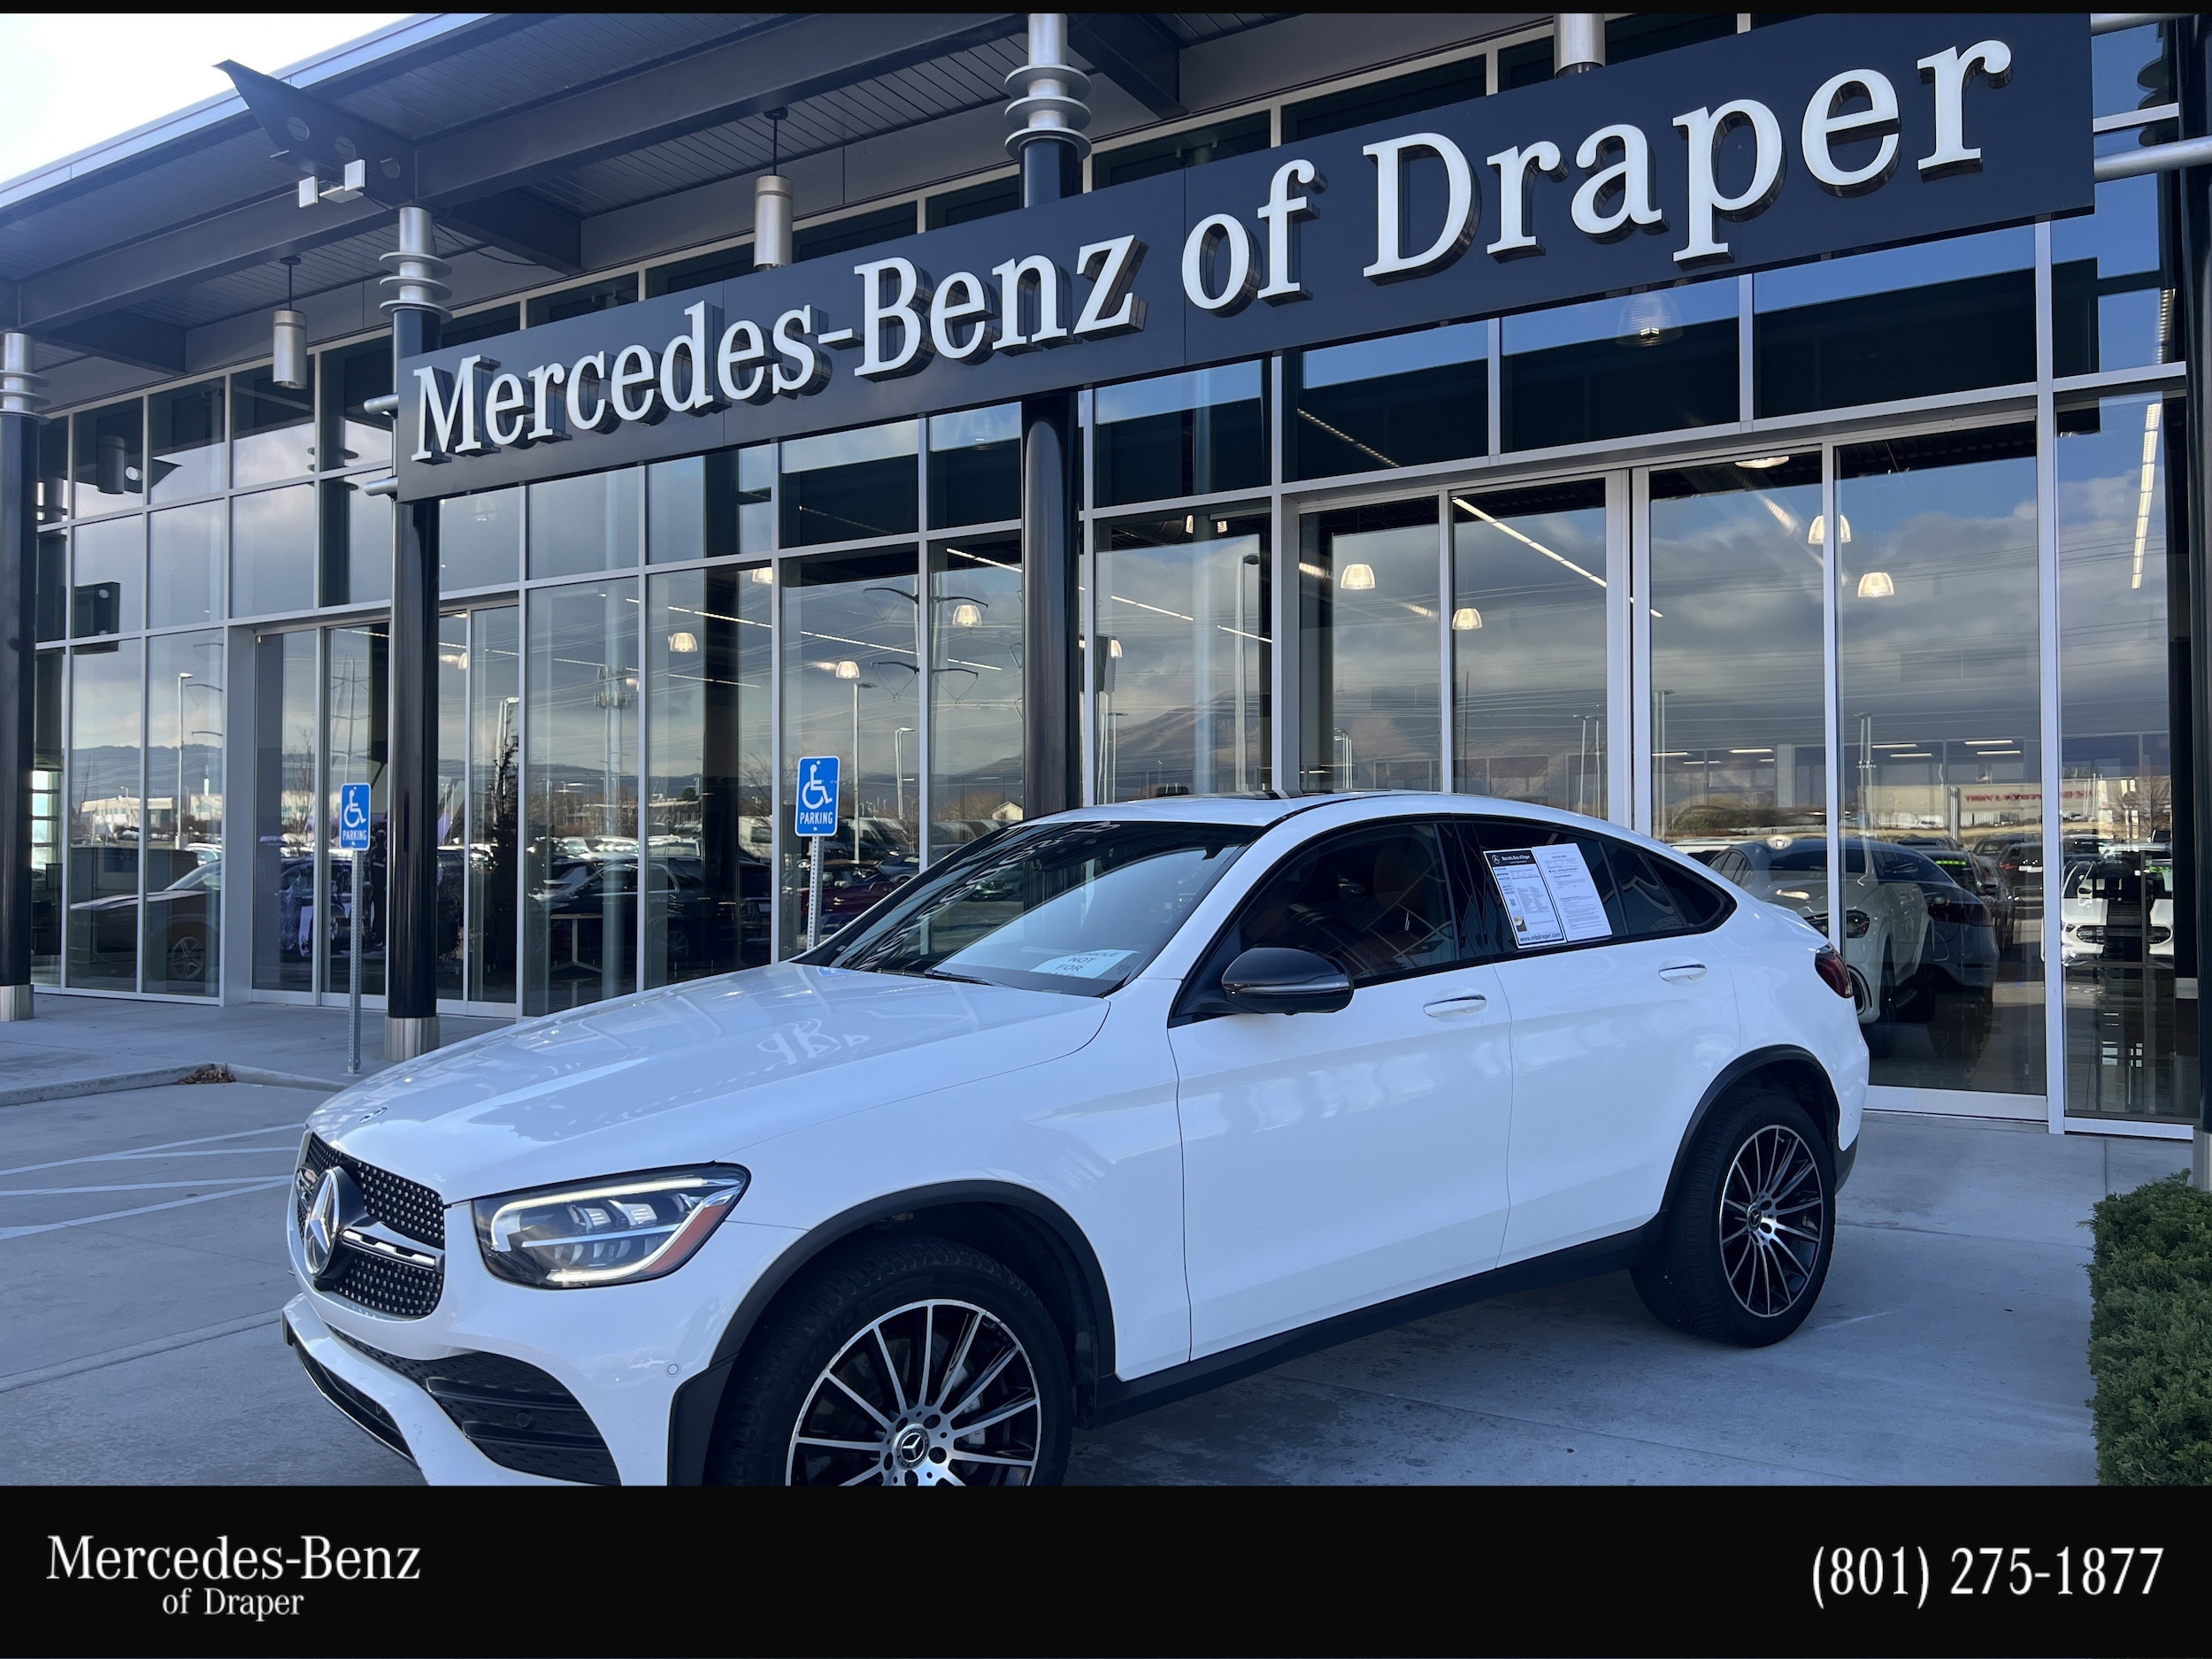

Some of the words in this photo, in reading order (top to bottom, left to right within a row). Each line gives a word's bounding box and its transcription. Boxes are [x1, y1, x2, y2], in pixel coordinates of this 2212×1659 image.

[411, 234, 1142, 465] Mercedes-Benz
[1181, 158, 1318, 311] of
[1363, 39, 2012, 265] Draper
[799, 811, 833, 825] PARKING
[342, 829, 367, 841] PARKING
[1519, 933, 1561, 942] www.mbdraper.com
